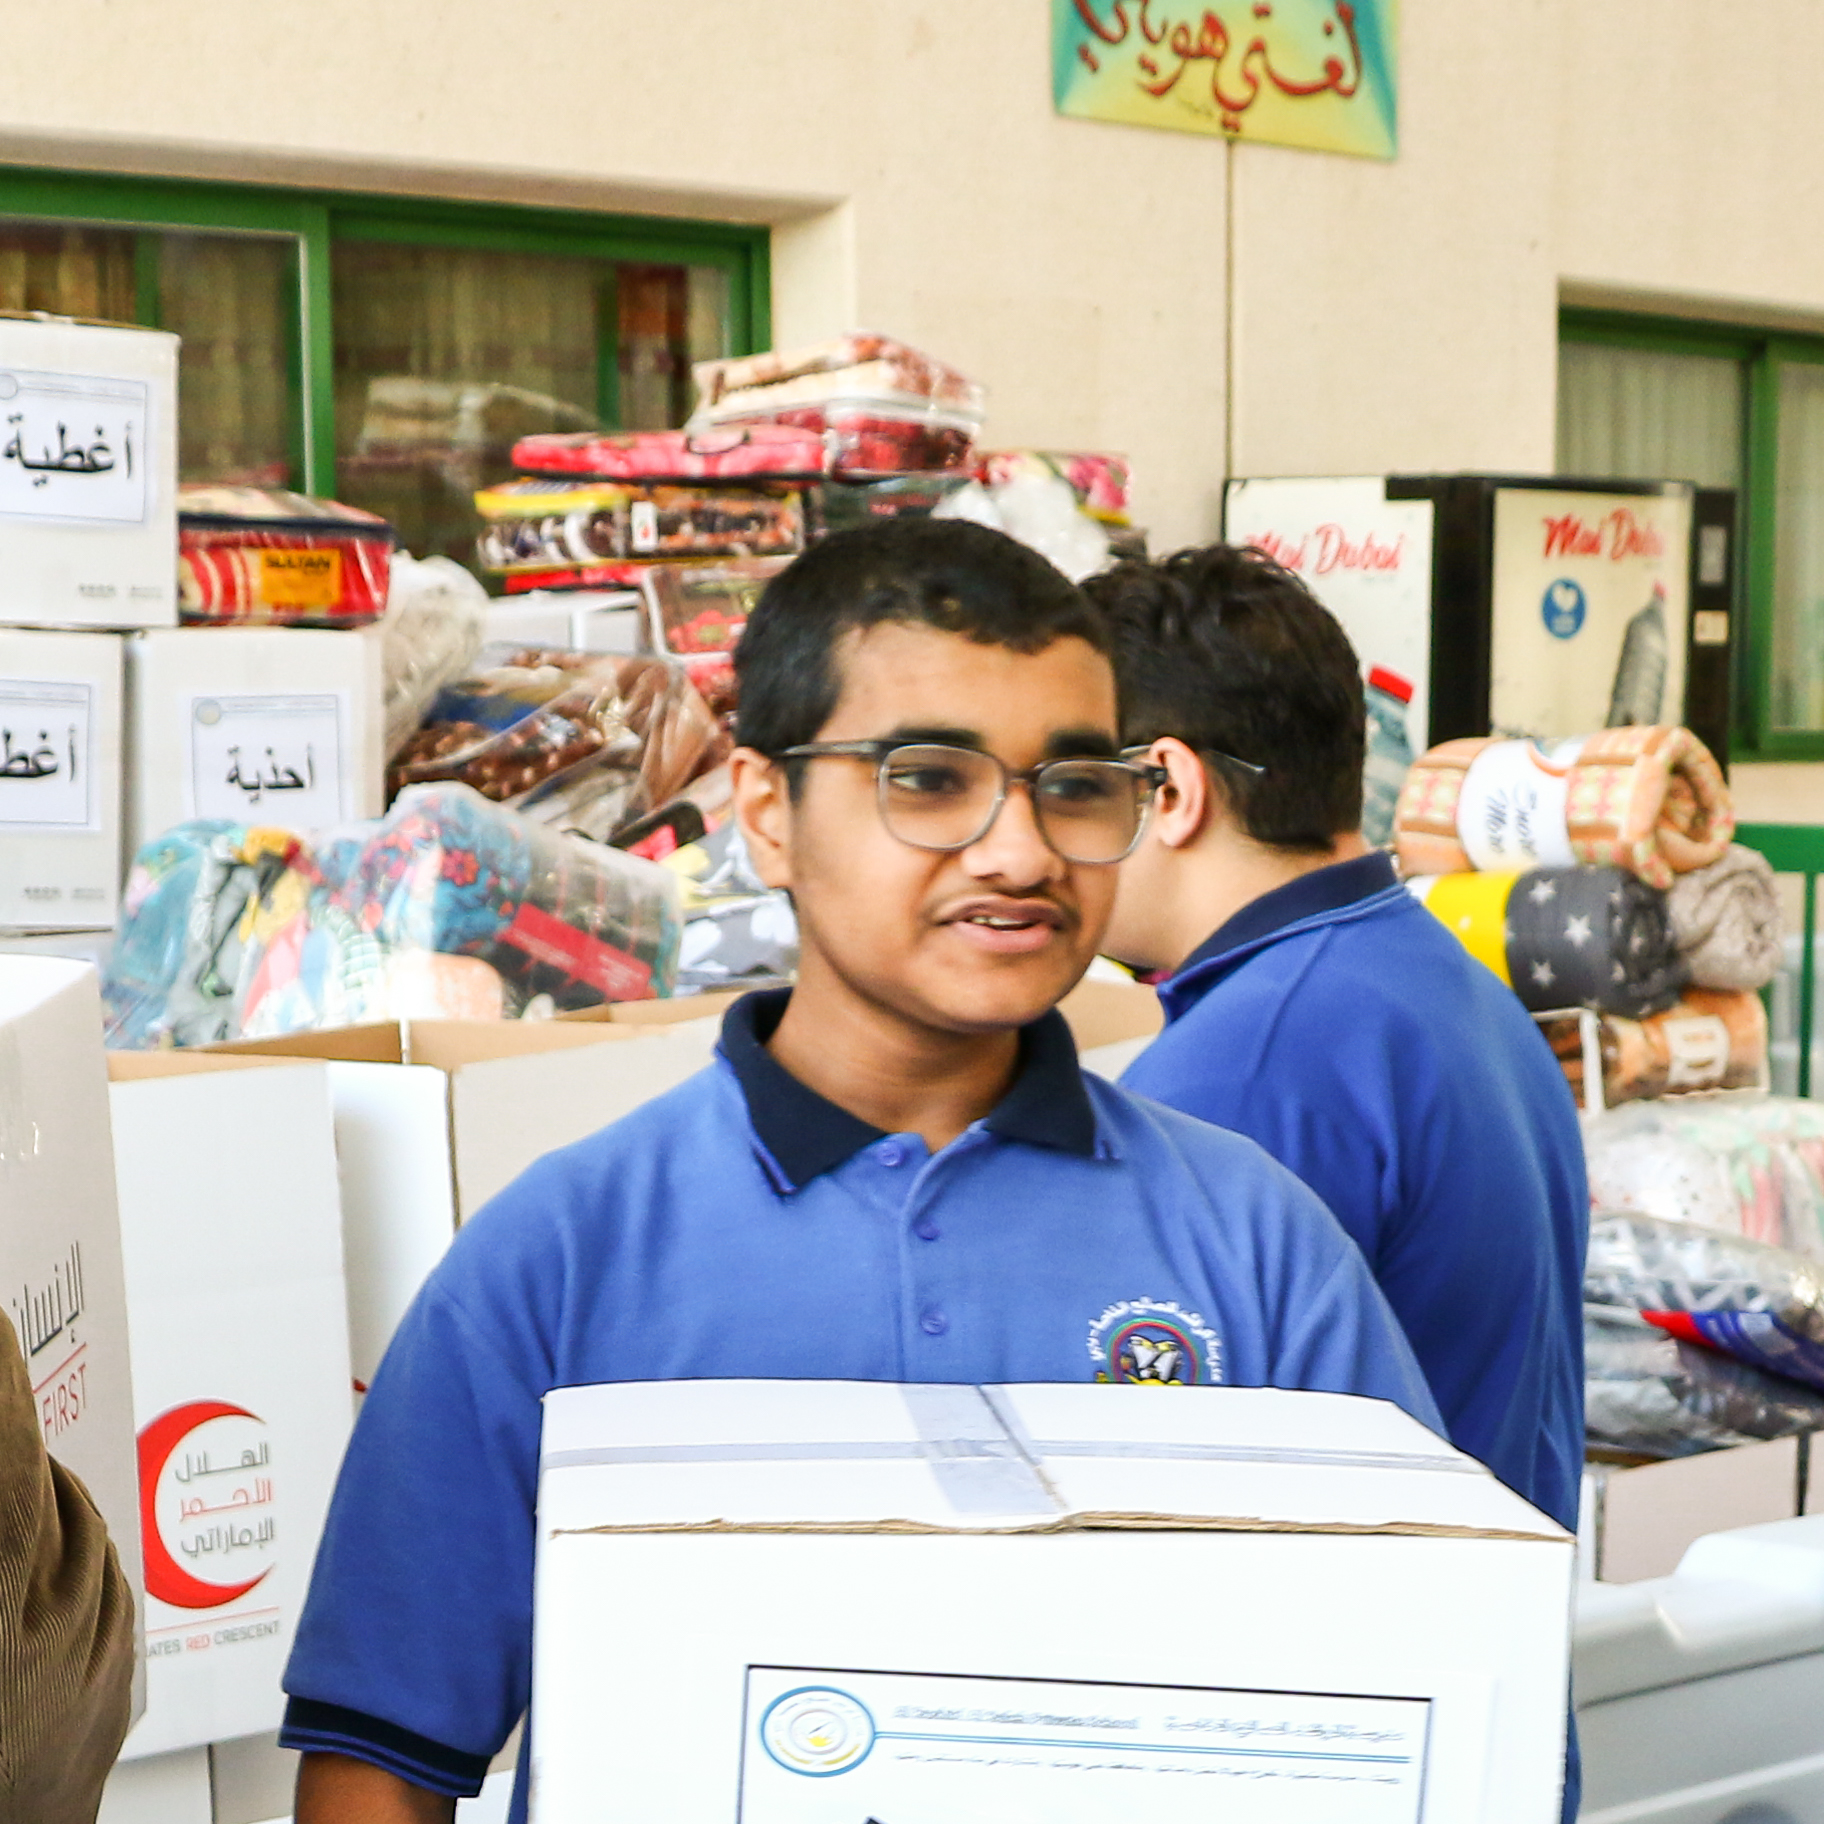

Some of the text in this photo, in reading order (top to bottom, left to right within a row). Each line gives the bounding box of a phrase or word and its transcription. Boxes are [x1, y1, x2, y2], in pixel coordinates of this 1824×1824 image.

[2, 412, 134, 488] أغطية
[225, 741, 314, 805] أحذية
[42, 1361, 87, 1446] FIRST
[175, 1440, 271, 1484] الهلال
[178, 1476, 273, 1524] الأحمر
[180, 1516, 275, 1559] الإماراتي
[147, 1638, 181, 1658] ATES
[214, 1619, 281, 1646] CRESCENT
